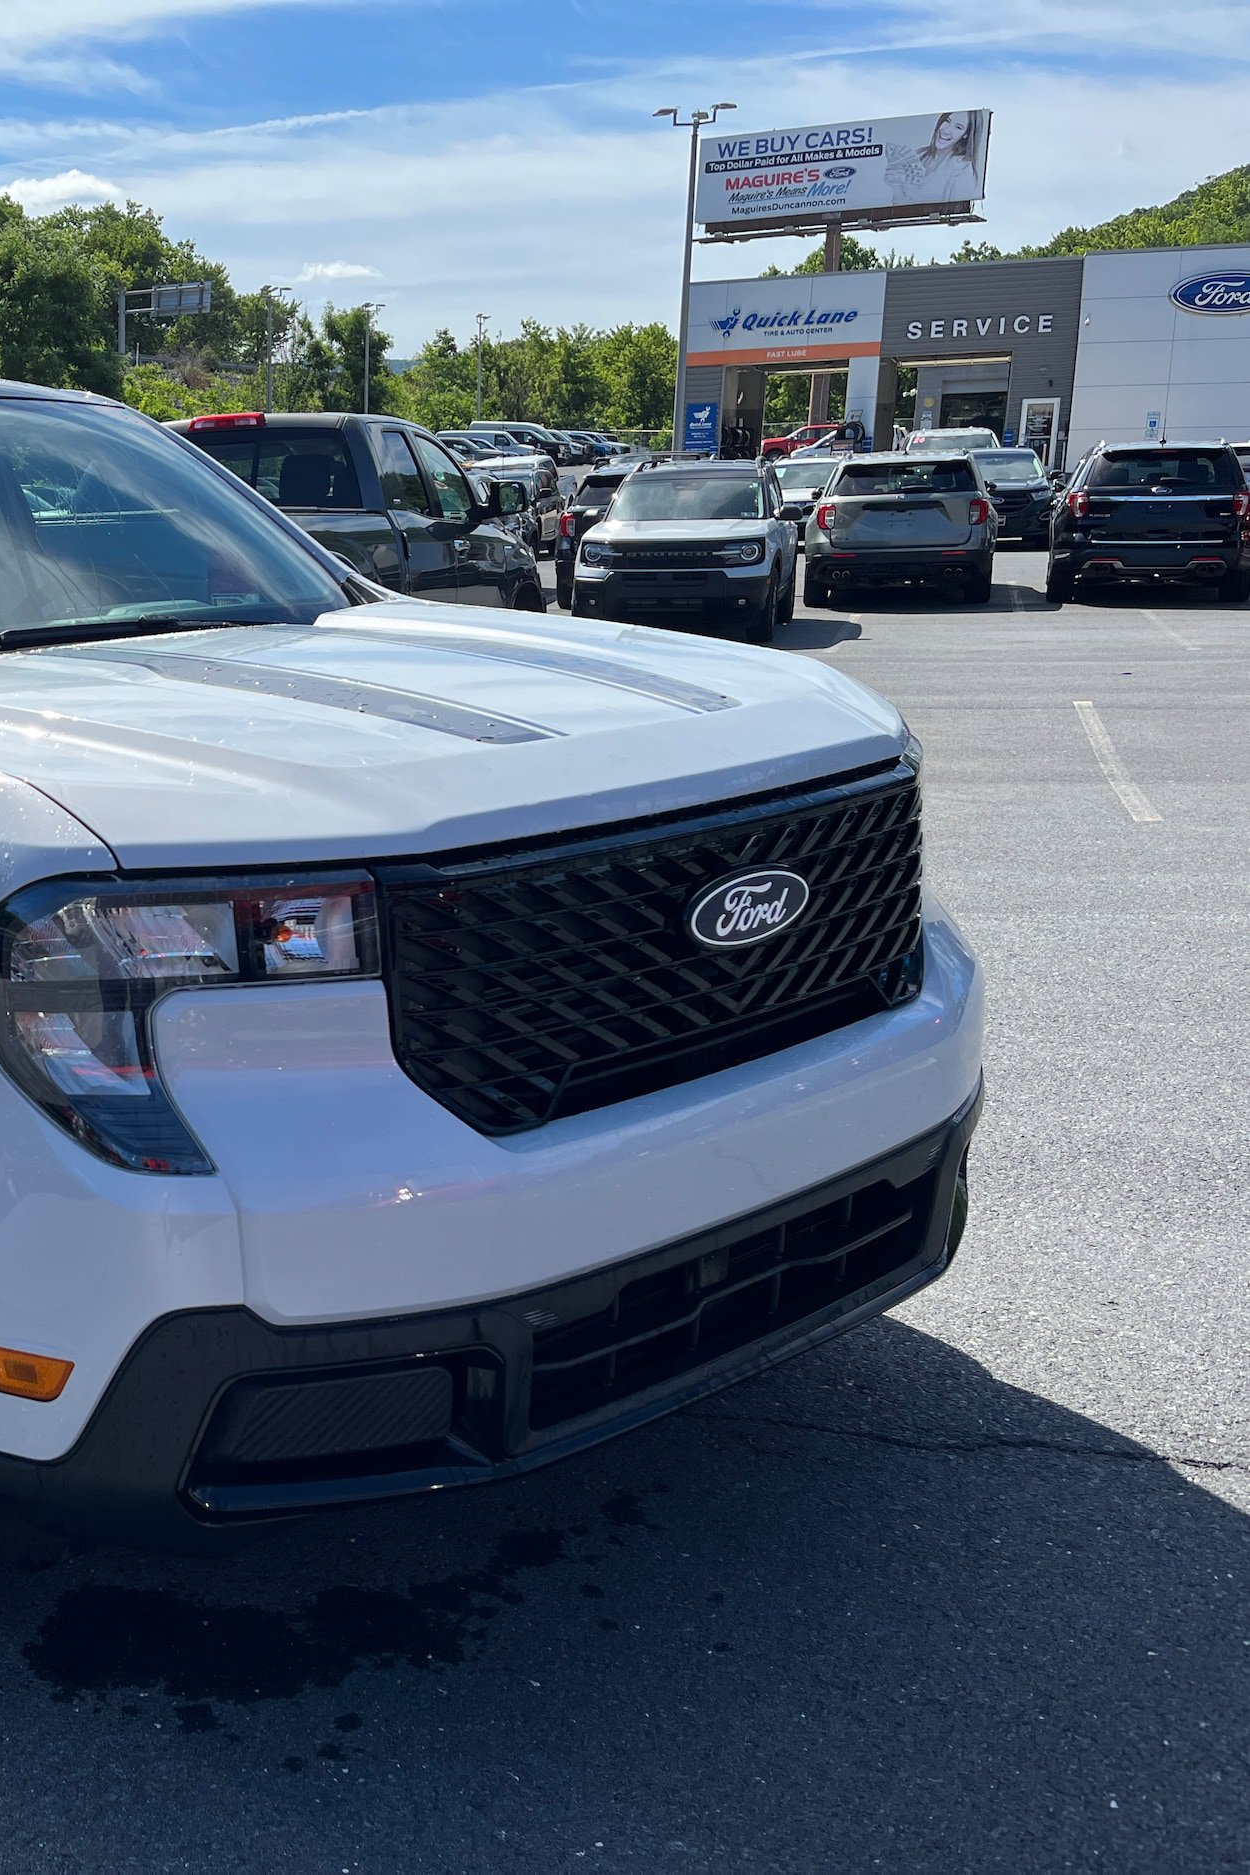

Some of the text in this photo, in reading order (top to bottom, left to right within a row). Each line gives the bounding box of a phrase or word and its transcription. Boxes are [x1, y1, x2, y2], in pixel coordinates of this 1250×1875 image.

[717, 127, 873, 159] WE BUY CARS!
[709, 146, 880, 172] Top Dollar Paid for All Makes & Models
[725, 168, 851, 191] MAGUIRE'S Ford
[728, 179, 852, 204] Maguire's Means More!
[731, 197, 846, 215] MaguiresDuncannon.com
[741, 309, 859, 331] Quick Lane
[786, 328, 804, 336] AUTO
[805, 327, 833, 335] CENTER
[906, 314, 1054, 340] SERVICE
[766, 349, 807, 359] FAST LUBE
[715, 881, 789, 937] Ford
